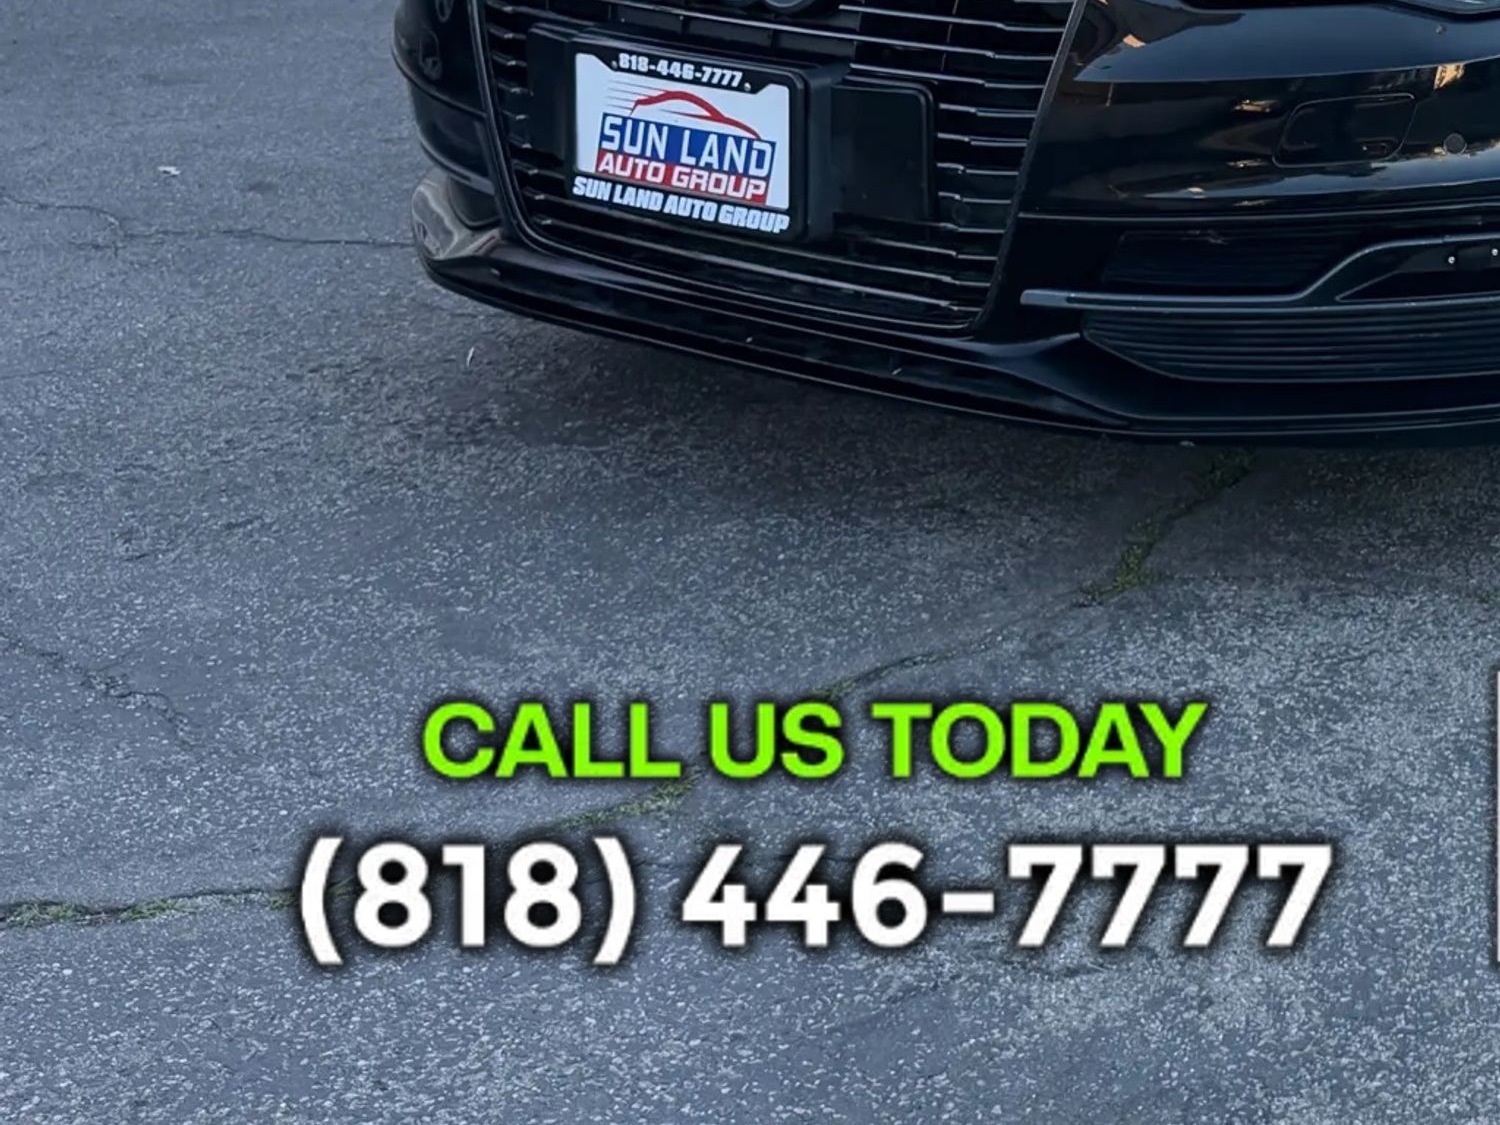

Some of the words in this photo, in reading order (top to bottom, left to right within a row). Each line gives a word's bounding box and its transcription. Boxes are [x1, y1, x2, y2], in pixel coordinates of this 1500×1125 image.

[618, 52, 743, 88] 818-446-7777
[601, 115, 669, 161] SUN
[679, 129, 774, 178] LAND
[598, 152, 666, 184] AUTO
[670, 164, 767, 201] GROUP
[572, 175, 613, 202] SUN
[611, 183, 665, 212] LAND
[662, 194, 719, 220] AUTO
[717, 204, 791, 234] GROUP
